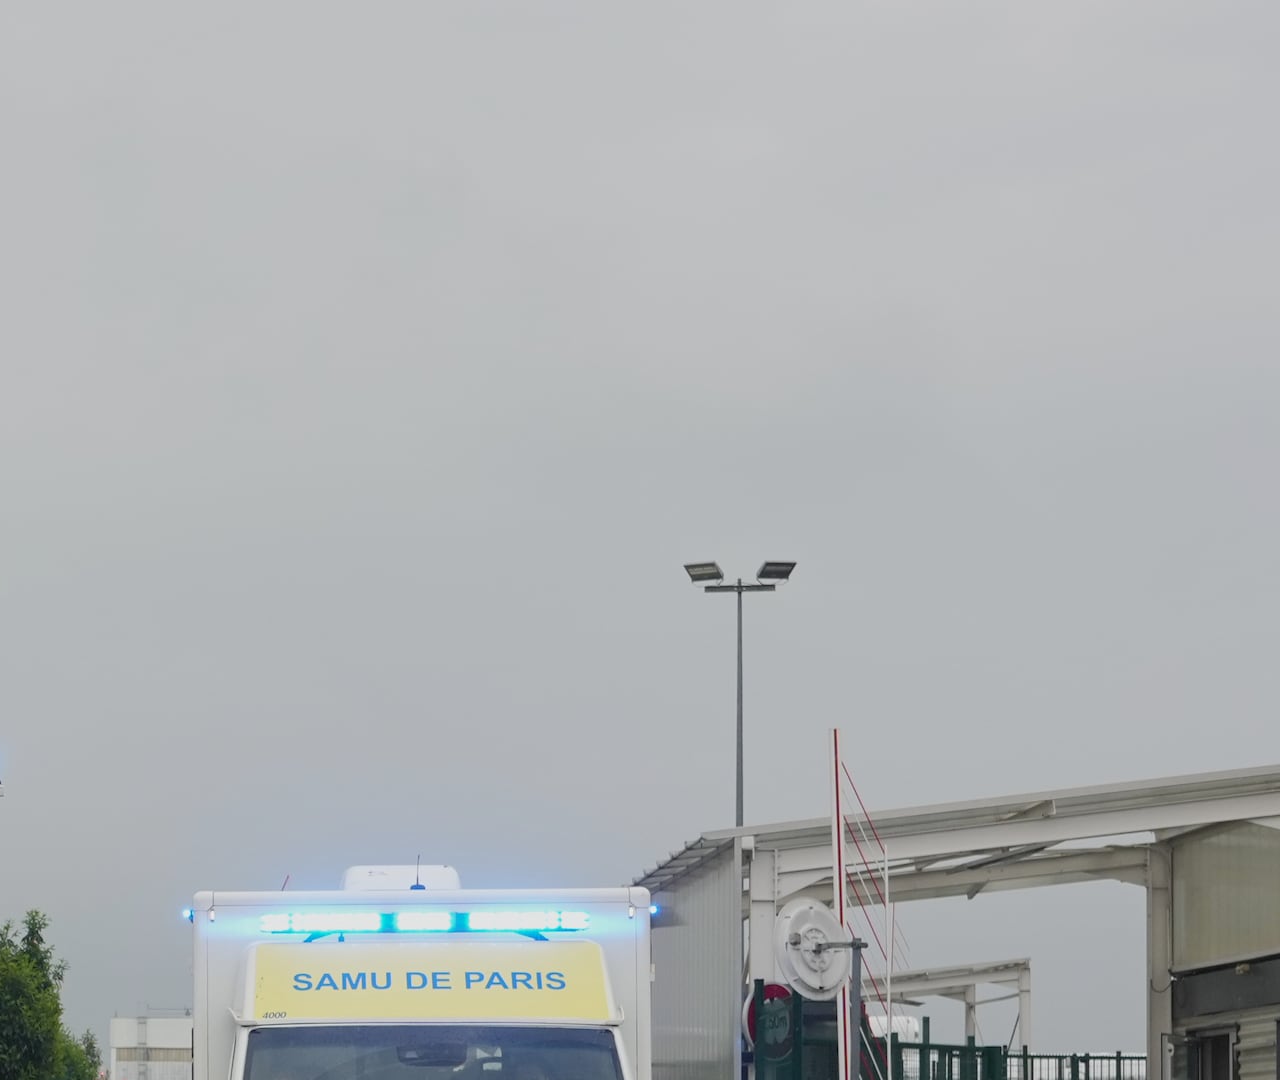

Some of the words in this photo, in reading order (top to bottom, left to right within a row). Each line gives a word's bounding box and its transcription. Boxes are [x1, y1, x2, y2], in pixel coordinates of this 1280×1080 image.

[292, 972, 392, 991] SAMU
[406, 971, 453, 990] DE
[464, 971, 567, 991] PARIS
[262, 1011, 287, 1019] 4000
